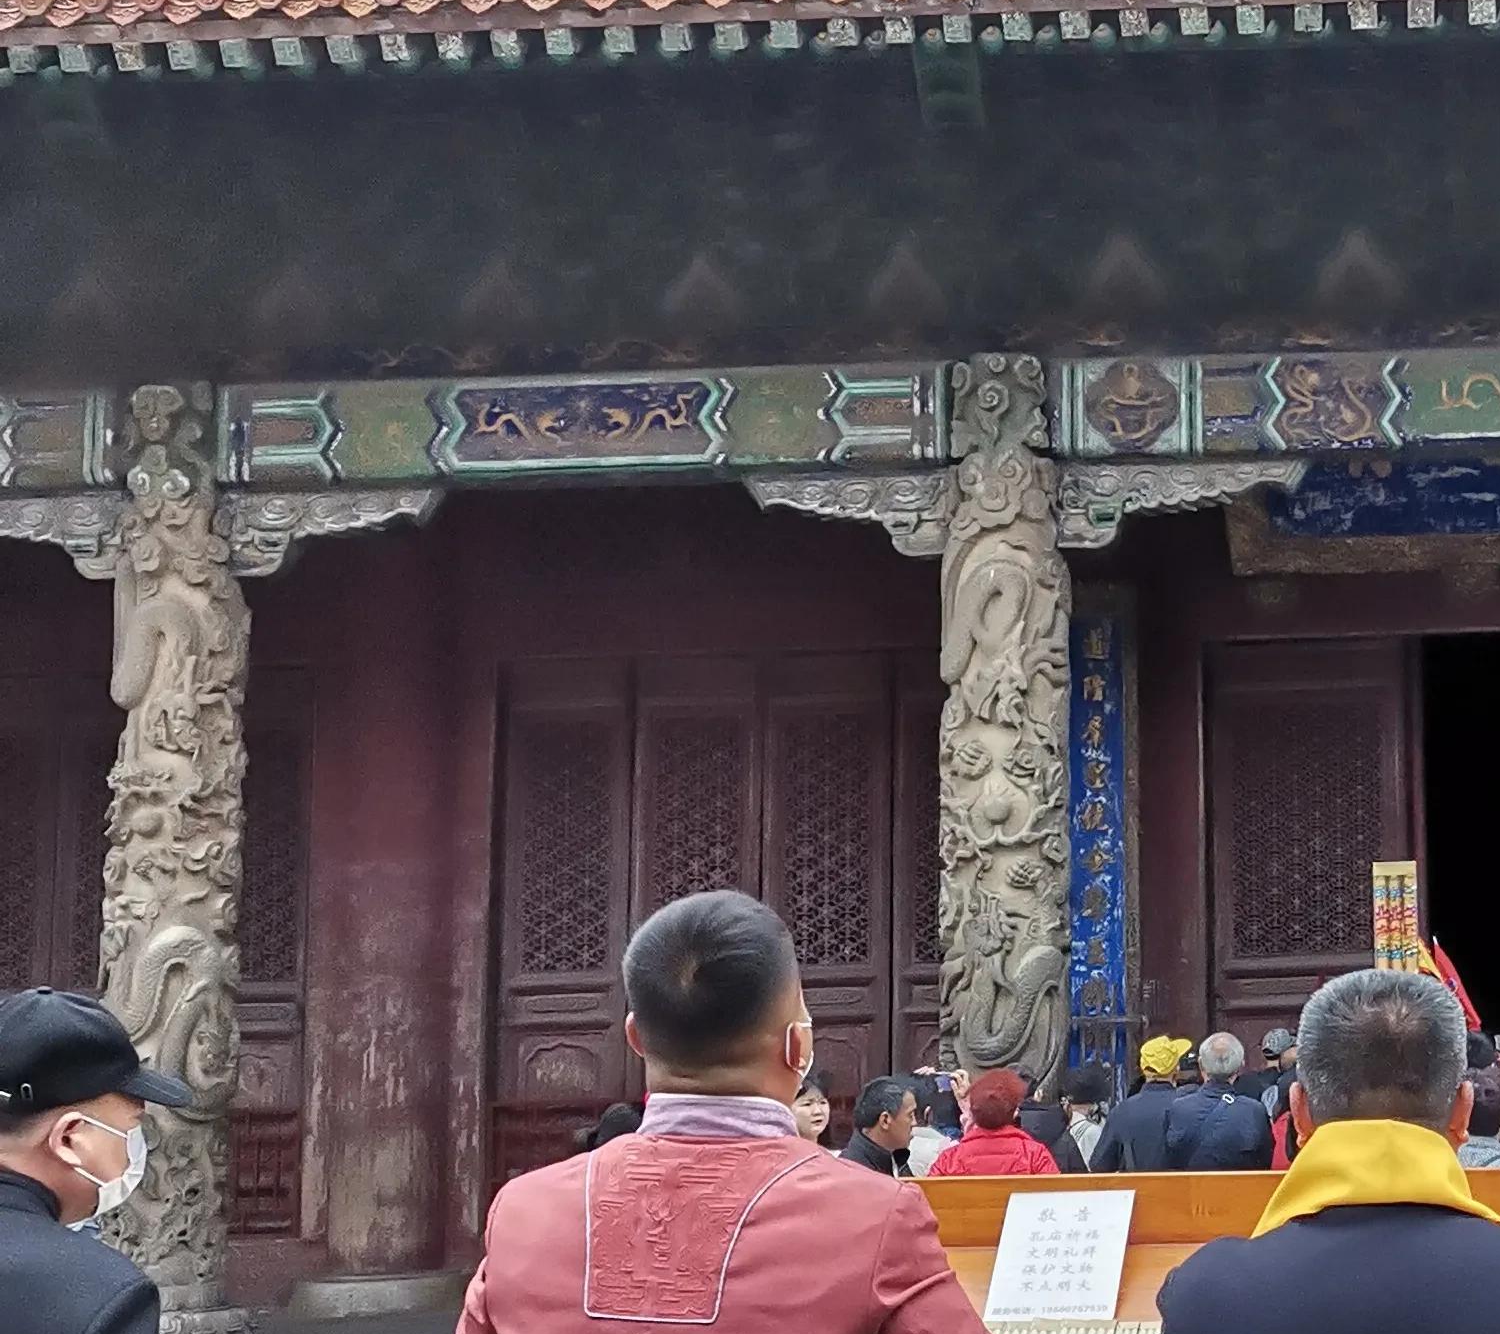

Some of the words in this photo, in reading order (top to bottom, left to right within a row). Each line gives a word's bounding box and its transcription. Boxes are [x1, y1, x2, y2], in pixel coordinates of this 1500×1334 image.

[1037, 1206, 1092, 1222] 敬告
[1028, 1229, 1101, 1243] 孔庙祈福
[1021, 1262, 1095, 1276] 保护文物
